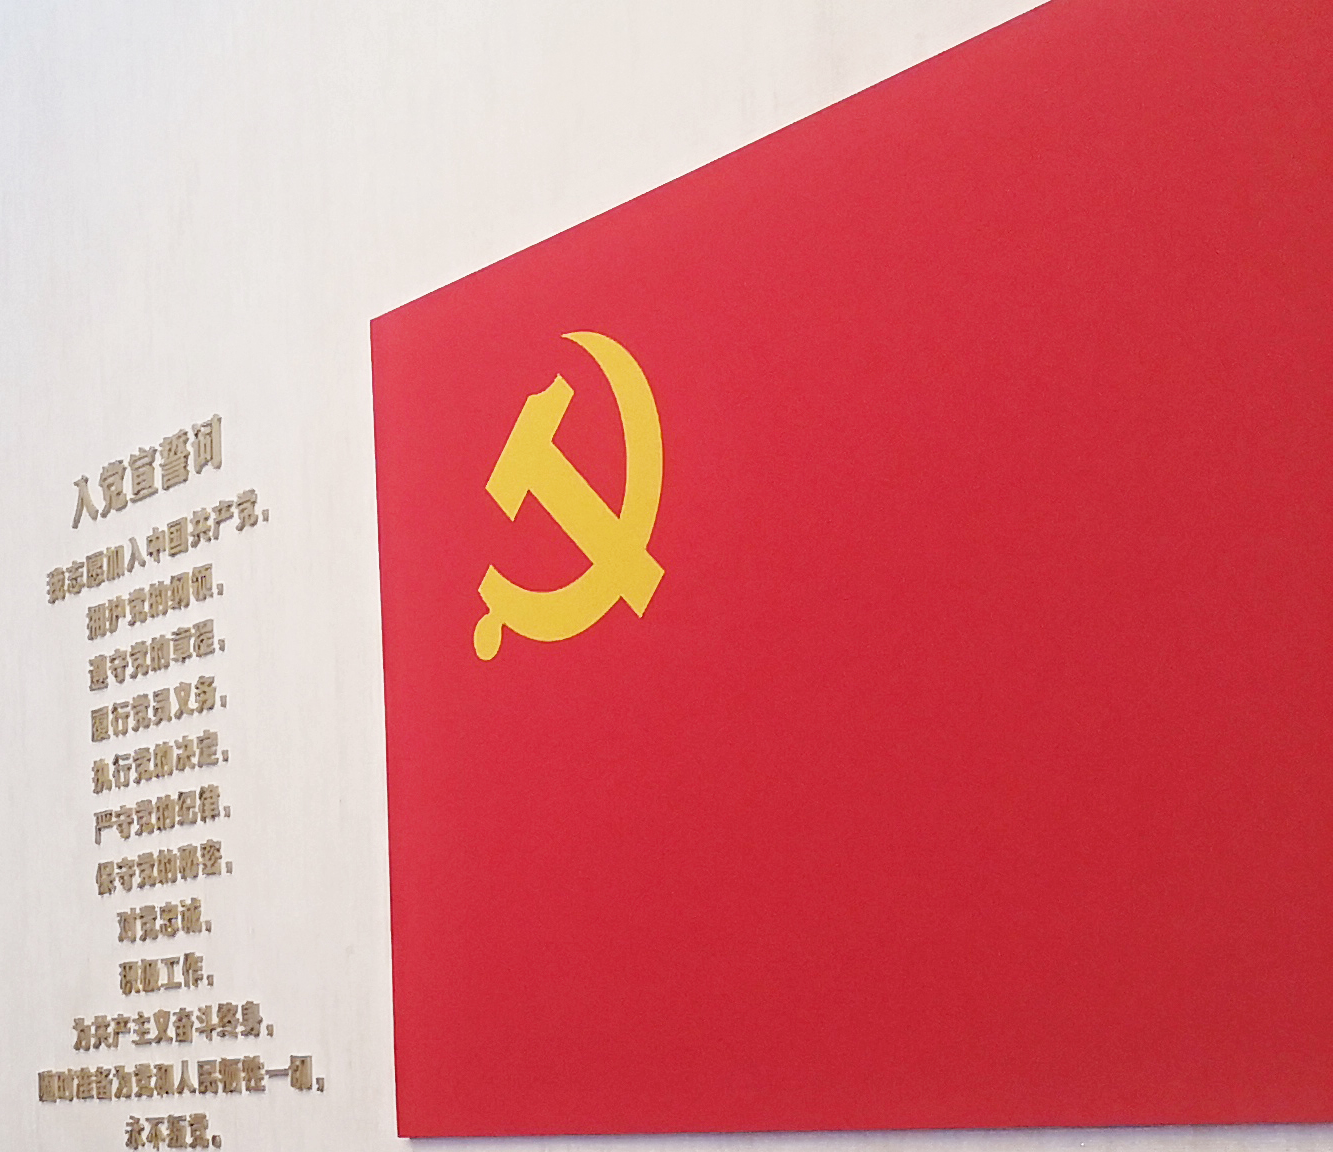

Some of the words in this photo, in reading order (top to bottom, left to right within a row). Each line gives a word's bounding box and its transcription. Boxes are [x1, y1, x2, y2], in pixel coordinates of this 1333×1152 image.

[72, 414, 223, 529] 入党宣誓词
